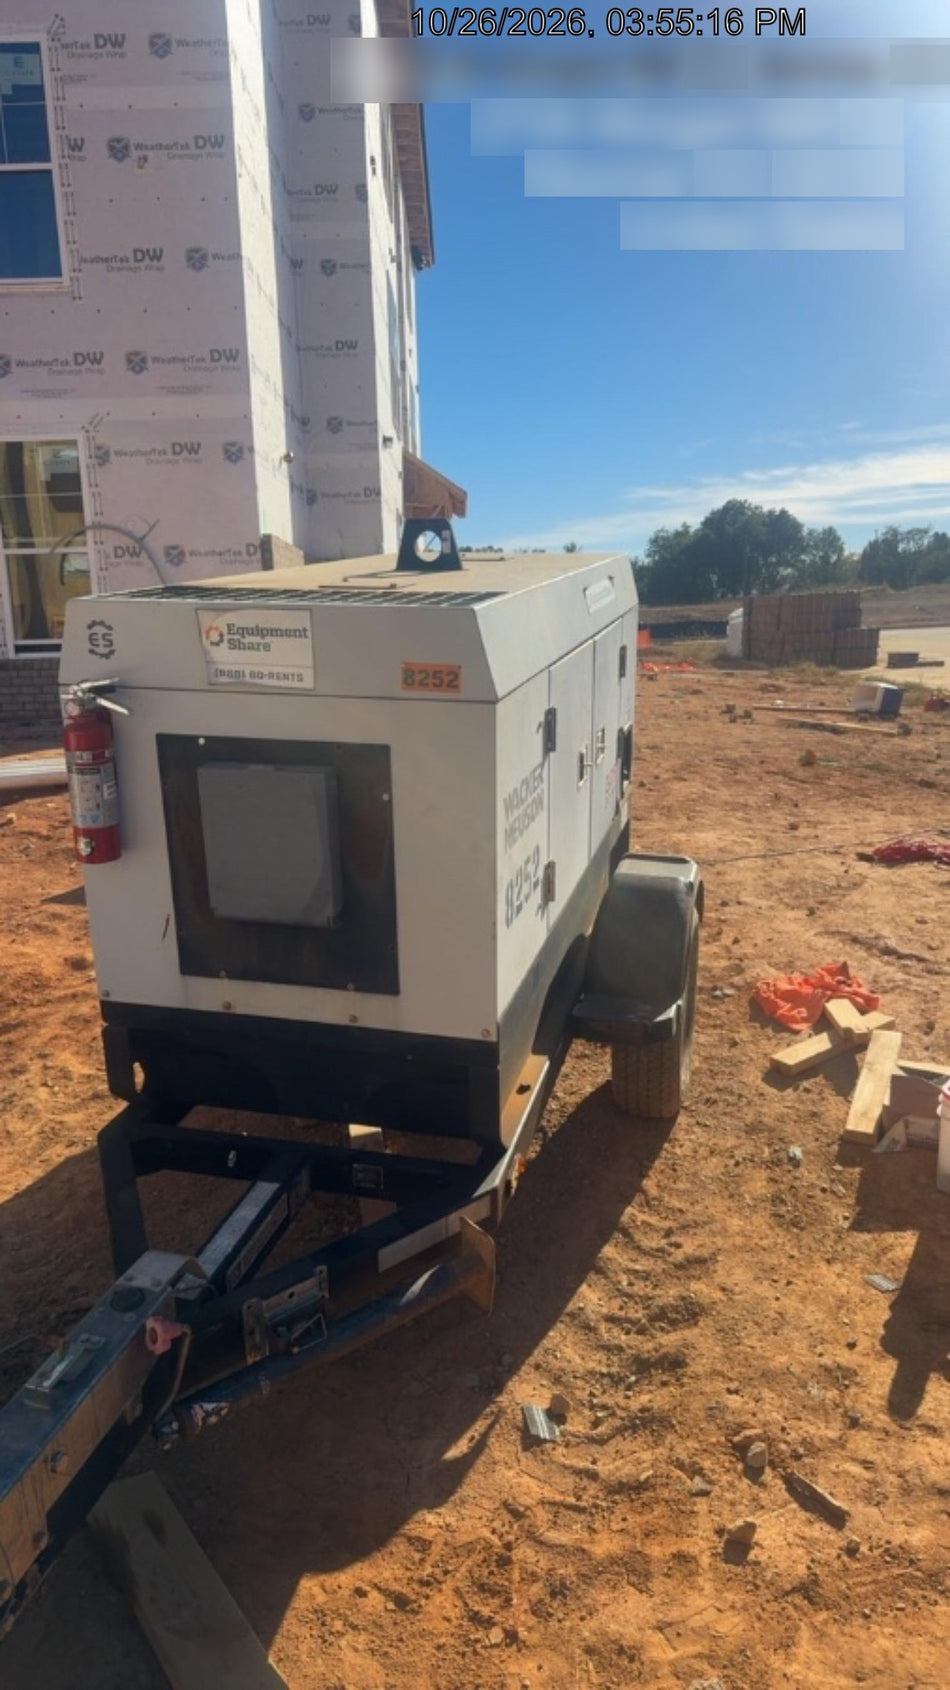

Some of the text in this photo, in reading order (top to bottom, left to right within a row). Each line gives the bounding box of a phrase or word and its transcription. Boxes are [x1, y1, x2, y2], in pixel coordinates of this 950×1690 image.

[306, 14, 331, 26] DW
[94, 33, 126, 49] DW
[132, 135, 225, 151] WeatherTek DW
[314, 183, 338, 196] DW
[133, 248, 164, 263] DW
[335, 339, 358, 352] DW
[15, 351, 104, 368] WeatherTek DW
[151, 348, 240, 365] WeatherTek DW
[113, 442, 202, 458] WeatherTek DW
[113, 545, 142, 559] DW
[226, 622, 310, 640] Equipment
[87, 631, 114, 648] ES
[226, 637, 272, 652] Share
[402, 668, 460, 689] 8252
[502, 760, 545, 822] WACKER
[504, 787, 545, 856] NEUSON
[504, 843, 541, 930] 8252
